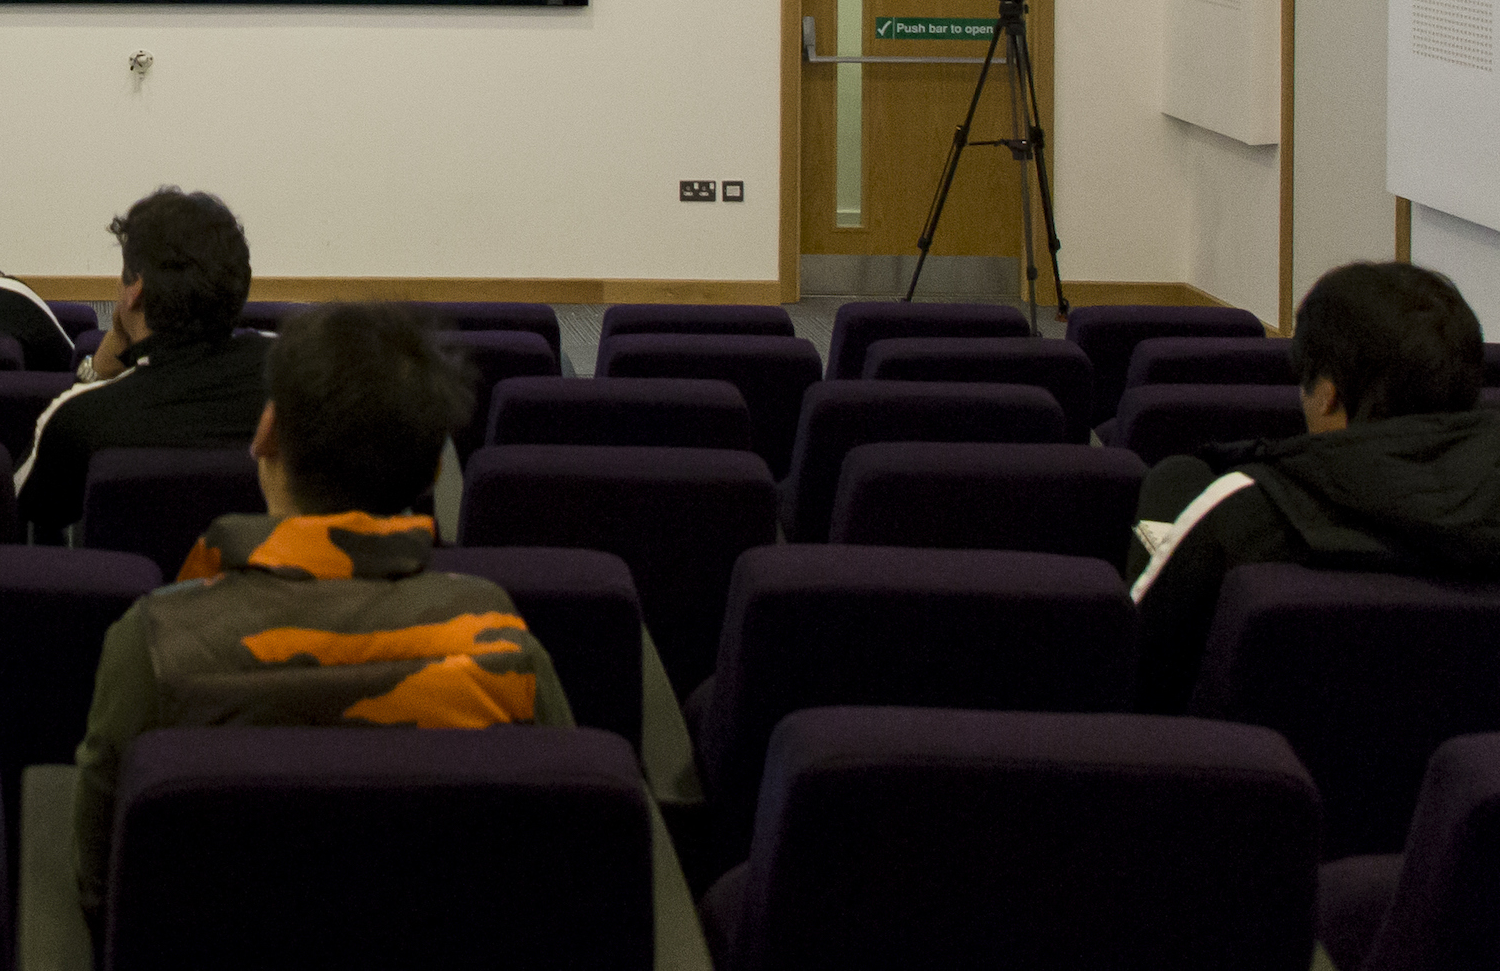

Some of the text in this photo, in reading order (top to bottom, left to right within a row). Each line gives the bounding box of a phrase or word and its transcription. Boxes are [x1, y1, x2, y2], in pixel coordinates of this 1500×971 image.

[896, 23, 994, 36] Push bar to open
